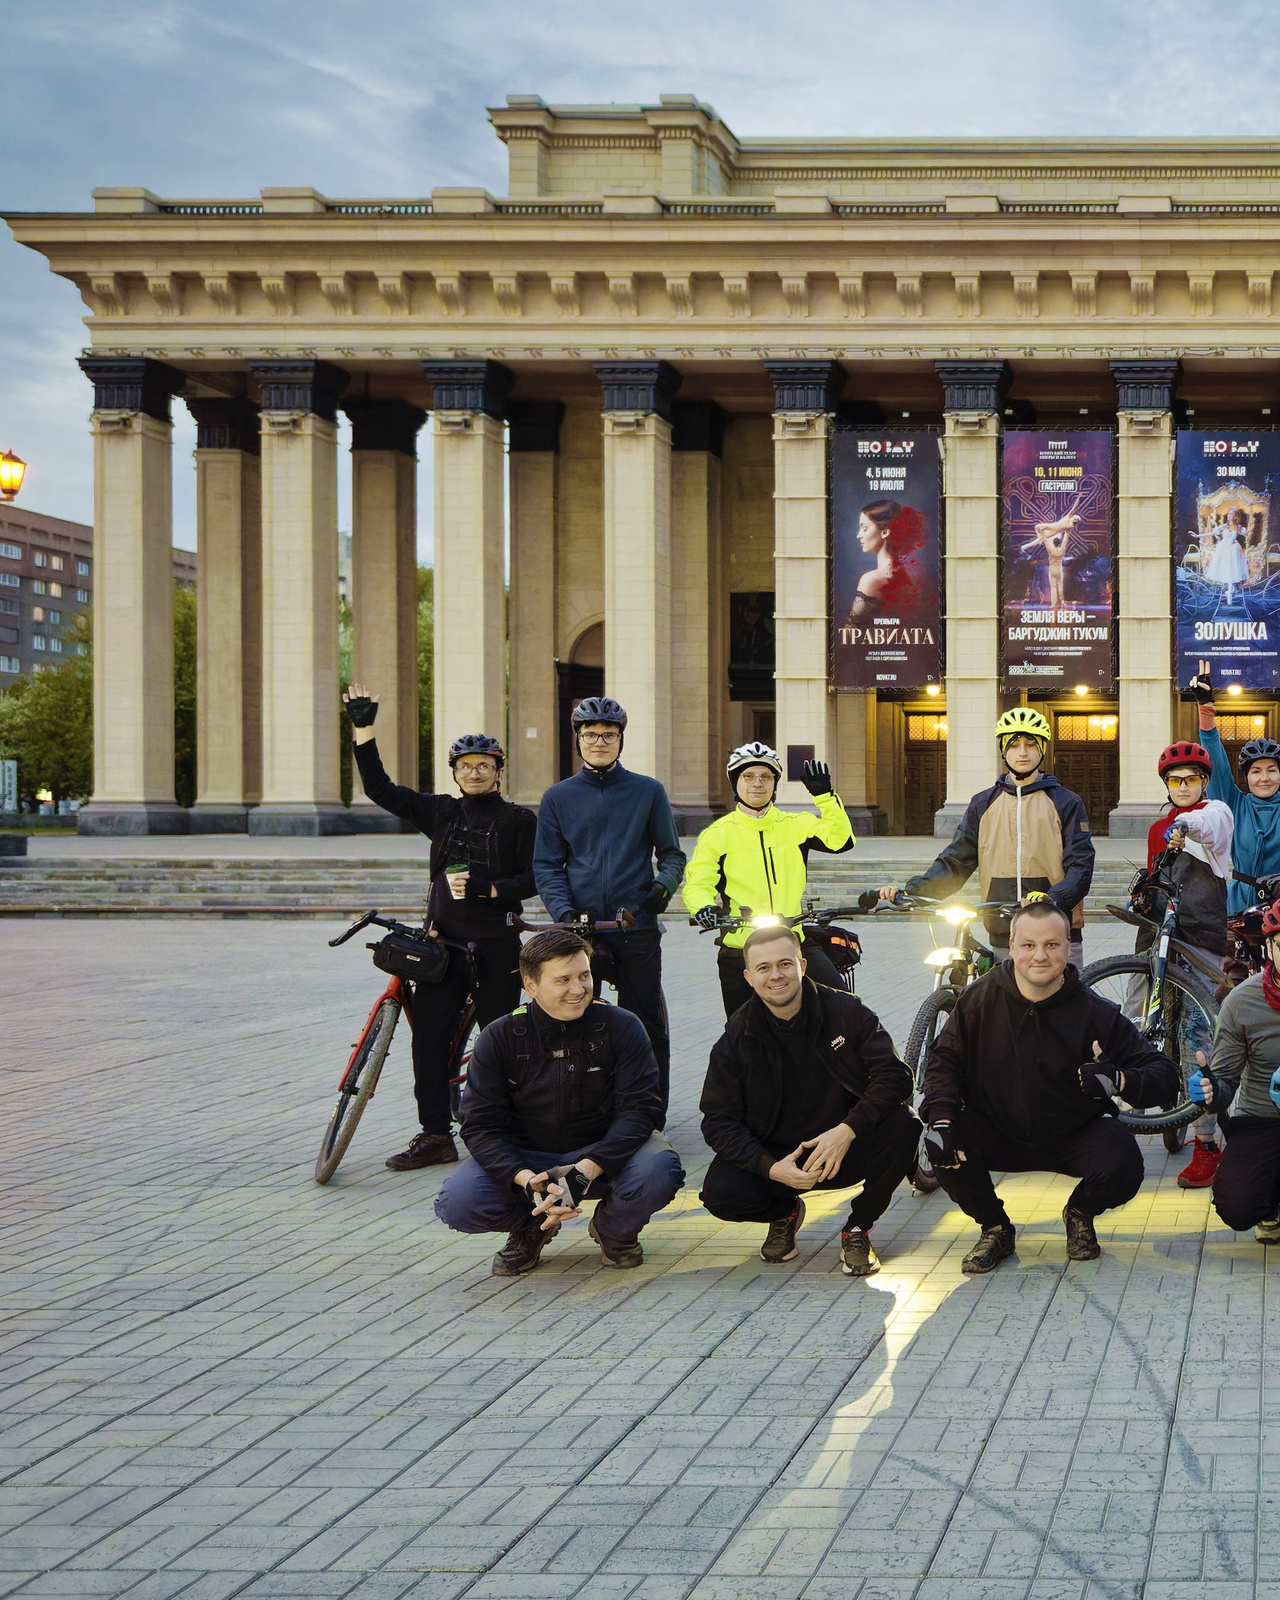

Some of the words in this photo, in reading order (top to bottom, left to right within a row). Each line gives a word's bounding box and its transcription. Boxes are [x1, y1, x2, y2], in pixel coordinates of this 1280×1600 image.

[866, 467, 874, 478] 4,
[875, 467, 881, 478] 5
[882, 467, 906, 478] ИЮНЯ
[1034, 467, 1046, 477] 10,
[1048, 467, 1057, 477] 11
[1059, 467, 1083, 477] ИЮНЯ
[1216, 466, 1227, 477] 30
[1228, 466, 1246, 477] МАЯ
[869, 480, 878, 490] 19
[880, 480, 904, 490] ИЮЛЯ
[1041, 482, 1075, 490] ГАСТРОЛИ
[1020, 610, 1054, 623] ЗЕМЛЯ
[1057, 610, 1085, 623] ВЕРЫ
[1008, 627, 1070, 641] БАРГУДЖИН
[1072, 627, 1108, 640] ТУКУМ
[1194, 621, 1268, 640] ЗОЛУШКА
[838, 628, 934, 645] ТРАВИАТА
